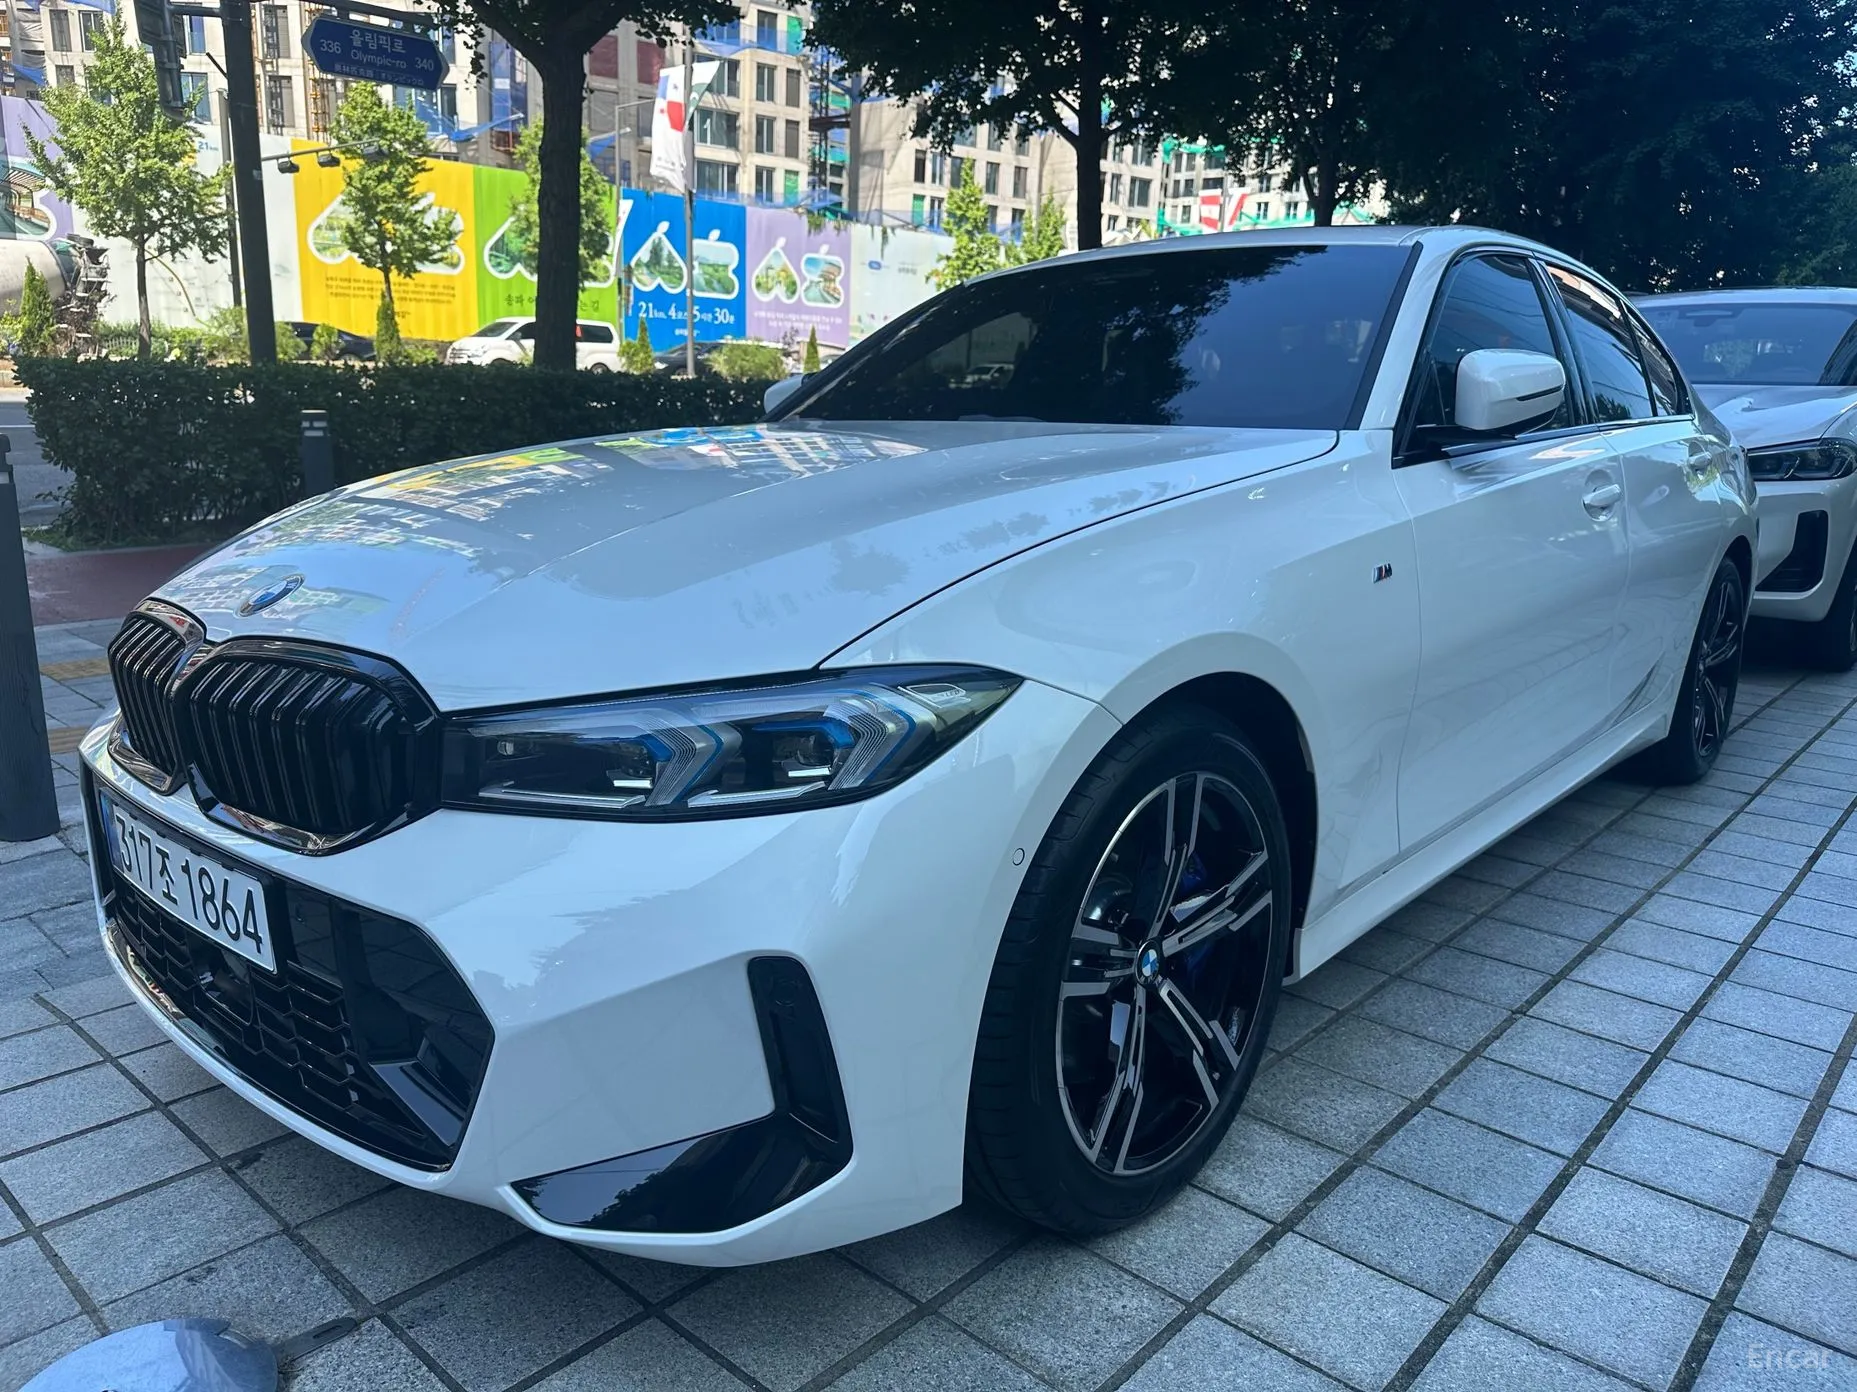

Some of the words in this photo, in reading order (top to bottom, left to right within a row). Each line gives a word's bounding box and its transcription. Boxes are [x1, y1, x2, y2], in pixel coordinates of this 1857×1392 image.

[319, 39, 342, 54] 336
[349, 29, 407, 54] 올림픽로
[350, 49, 407, 69] Olympic-ro
[414, 57, 435, 71] 340
[180, 856, 264, 954] 1864
